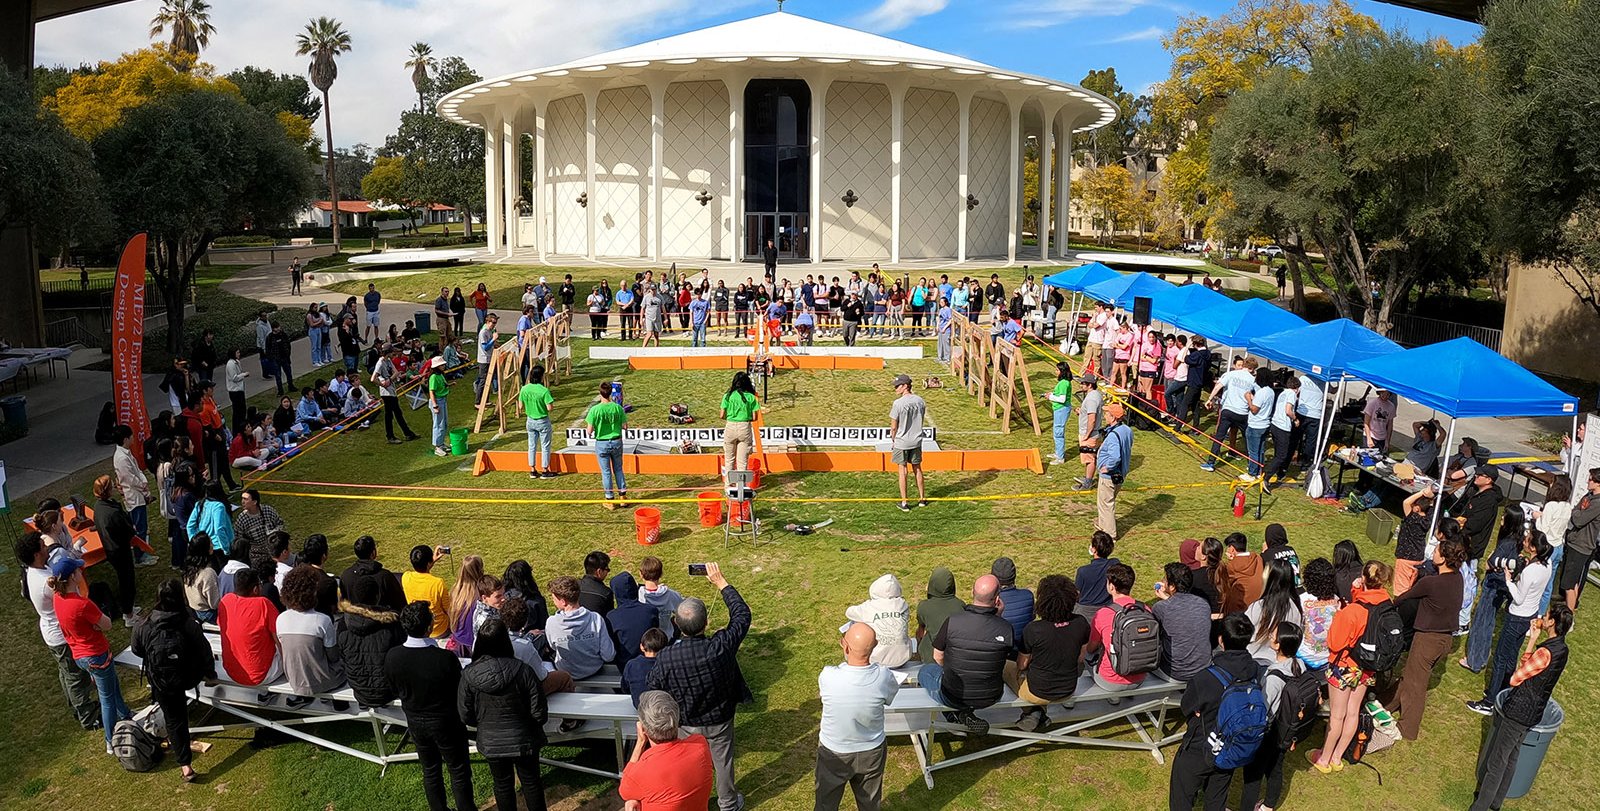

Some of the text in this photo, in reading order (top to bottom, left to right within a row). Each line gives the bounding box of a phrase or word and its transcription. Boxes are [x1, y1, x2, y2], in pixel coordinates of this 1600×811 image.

[116, 273, 129, 332] Design
[130, 283, 146, 441] ME72 Engineering
[1274, 550, 1296, 560] JAPAN
